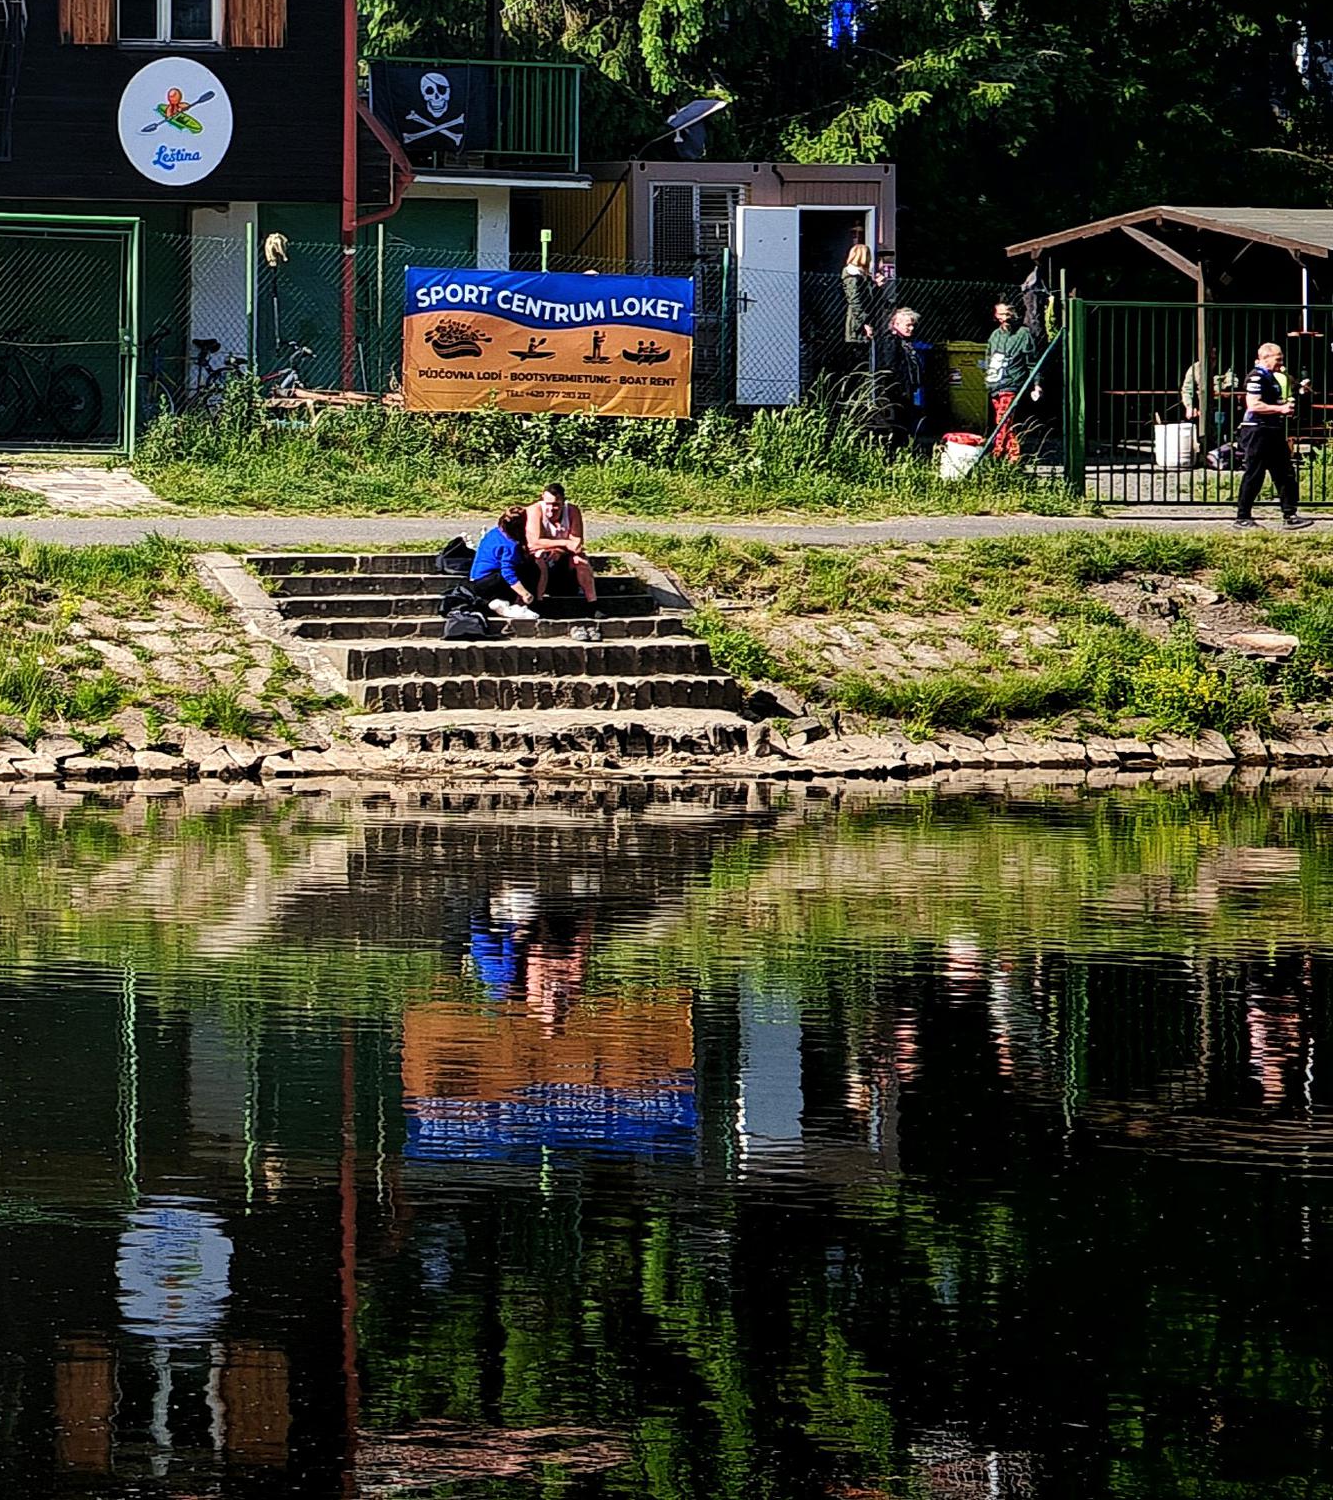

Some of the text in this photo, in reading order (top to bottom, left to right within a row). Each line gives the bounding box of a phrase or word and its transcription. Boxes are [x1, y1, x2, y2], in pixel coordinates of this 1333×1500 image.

[152, 145, 201, 170] Leština
[415, 284, 684, 323] SPORT CENTRUM LOKET
[418, 367, 475, 380] PŮJČOVNA
[477, 368, 502, 381] LODÍ
[510, 373, 611, 385] BOOTSVERMIETUNG
[619, 375, 647, 386] BOAT
[649, 377, 677, 387] RENT
